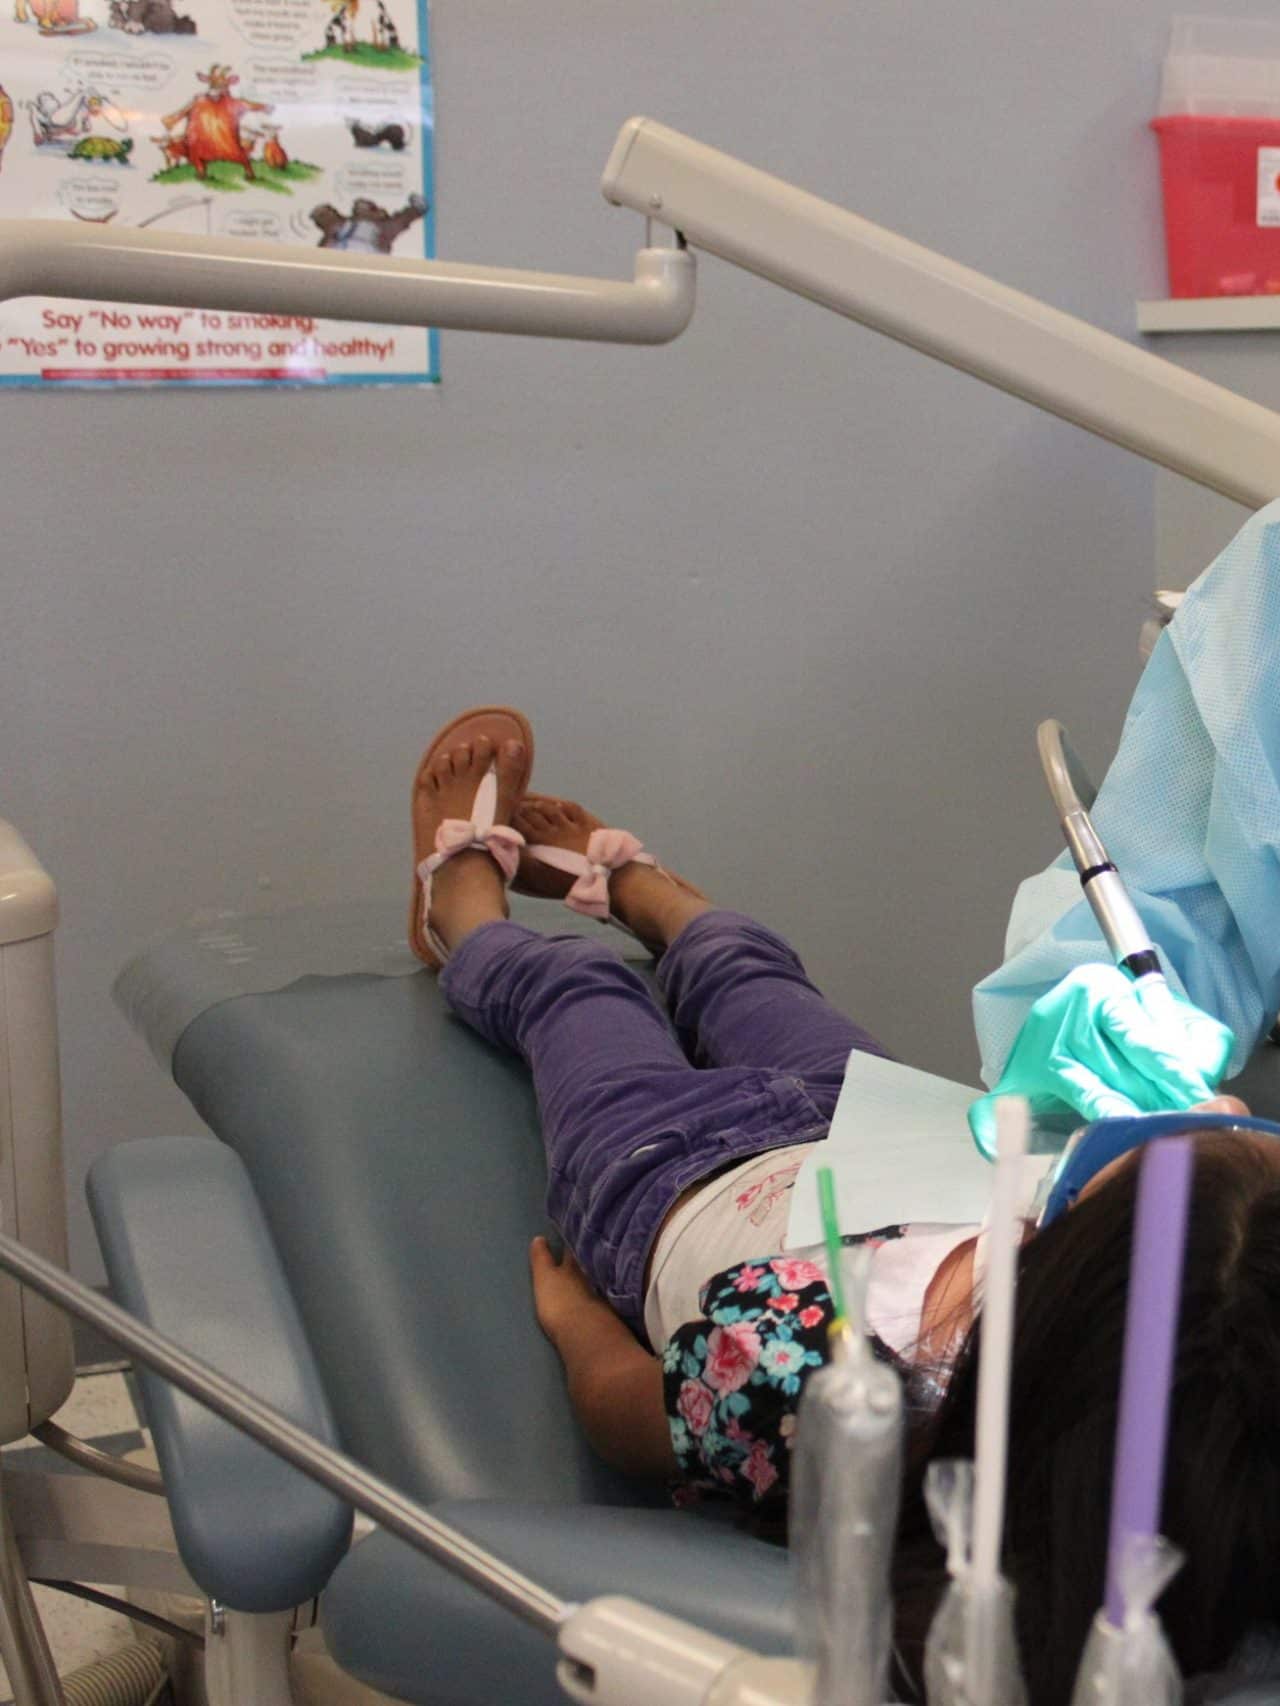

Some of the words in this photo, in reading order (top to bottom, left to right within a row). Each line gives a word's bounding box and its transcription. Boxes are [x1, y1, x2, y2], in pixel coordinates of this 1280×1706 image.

[41, 309, 83, 333] Say
[201, 313, 222, 330] to
[75, 338, 97, 357] to
[102, 338, 190, 361] growing
[196, 339, 262, 361] strong
[267, 338, 307, 357] and
[313, 337, 396, 361] healthy!
